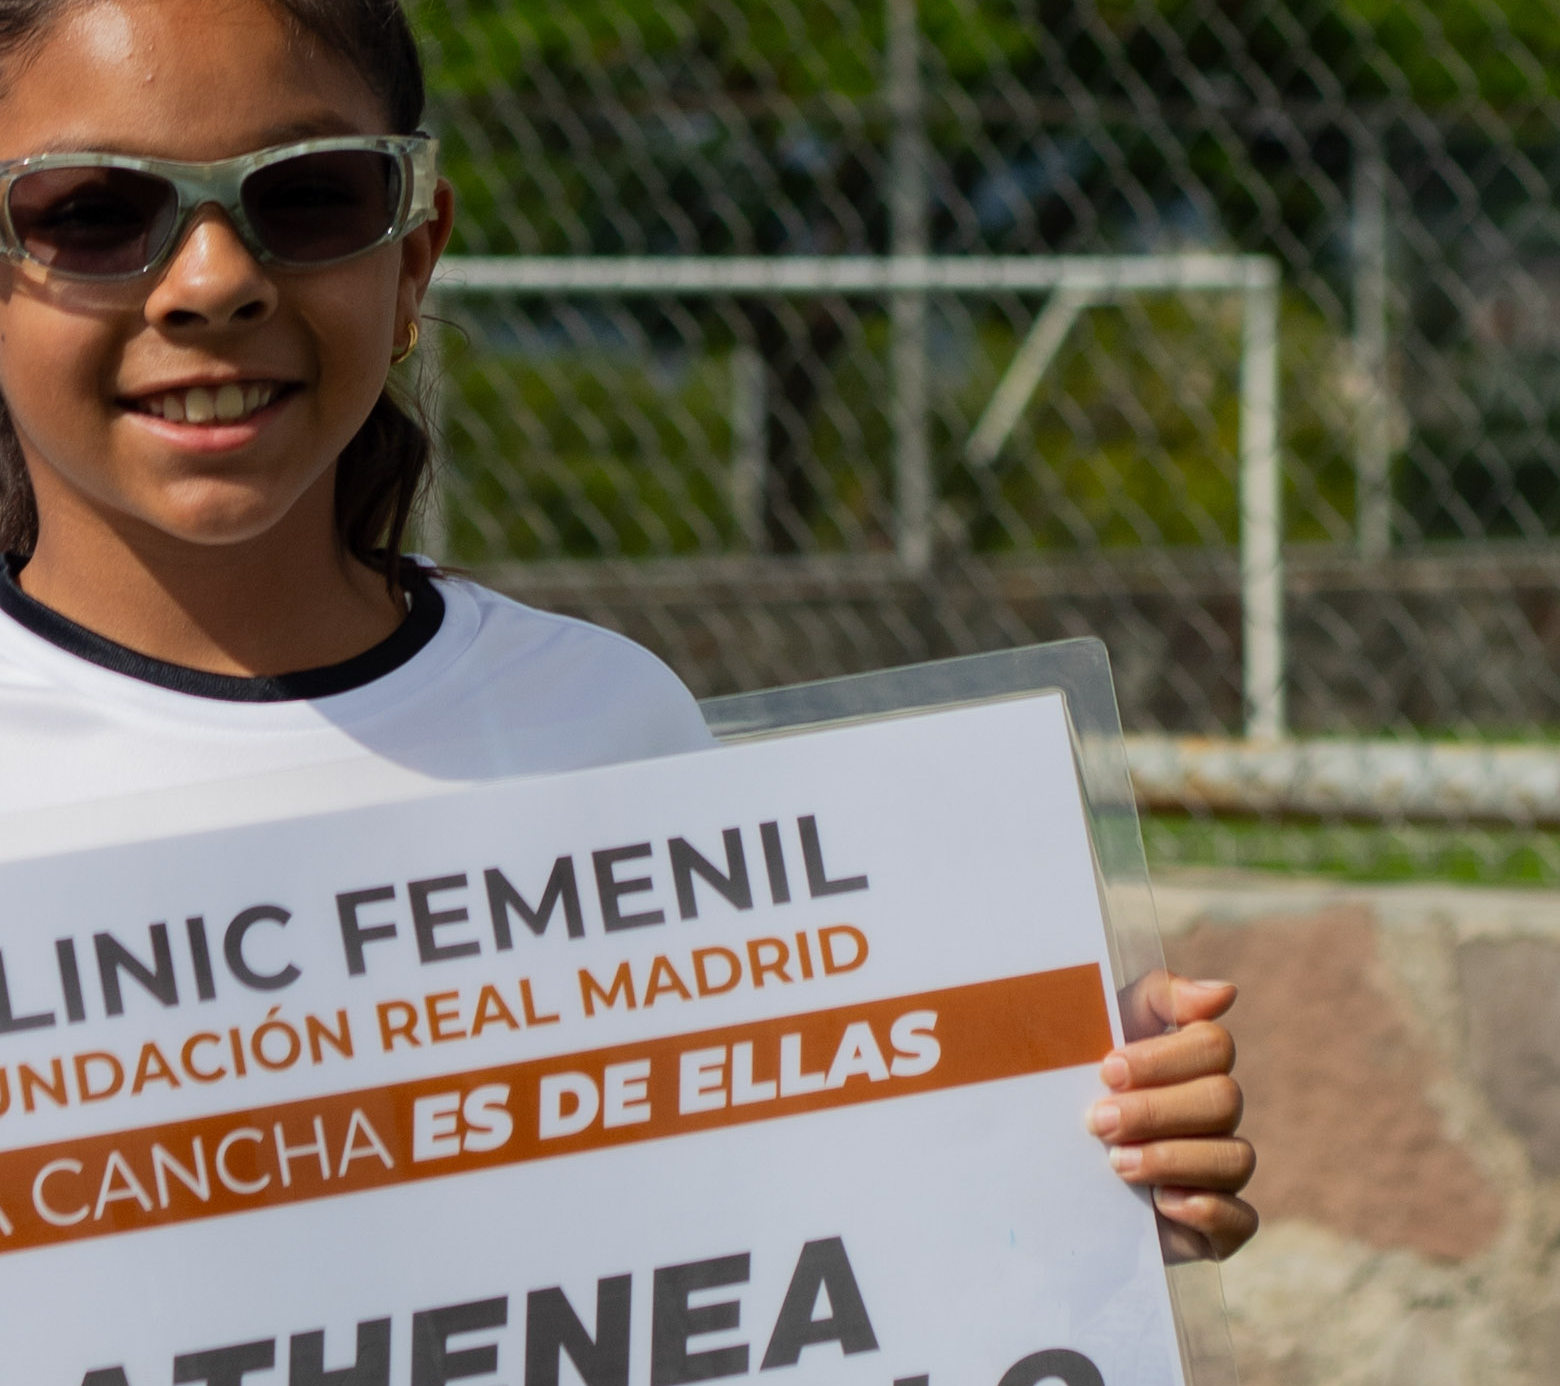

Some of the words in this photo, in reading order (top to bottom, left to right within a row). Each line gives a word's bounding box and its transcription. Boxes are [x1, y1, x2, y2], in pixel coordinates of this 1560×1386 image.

[334, 814, 870, 978] FEMENIL
[377, 978, 561, 1052] REAL
[577, 924, 870, 1018] MADRID
[31, 1109, 395, 1227] CANCHA
[412, 1083, 514, 1163] ES
[539, 1057, 652, 1142] DE
[679, 1010, 942, 1116] ELLAS
